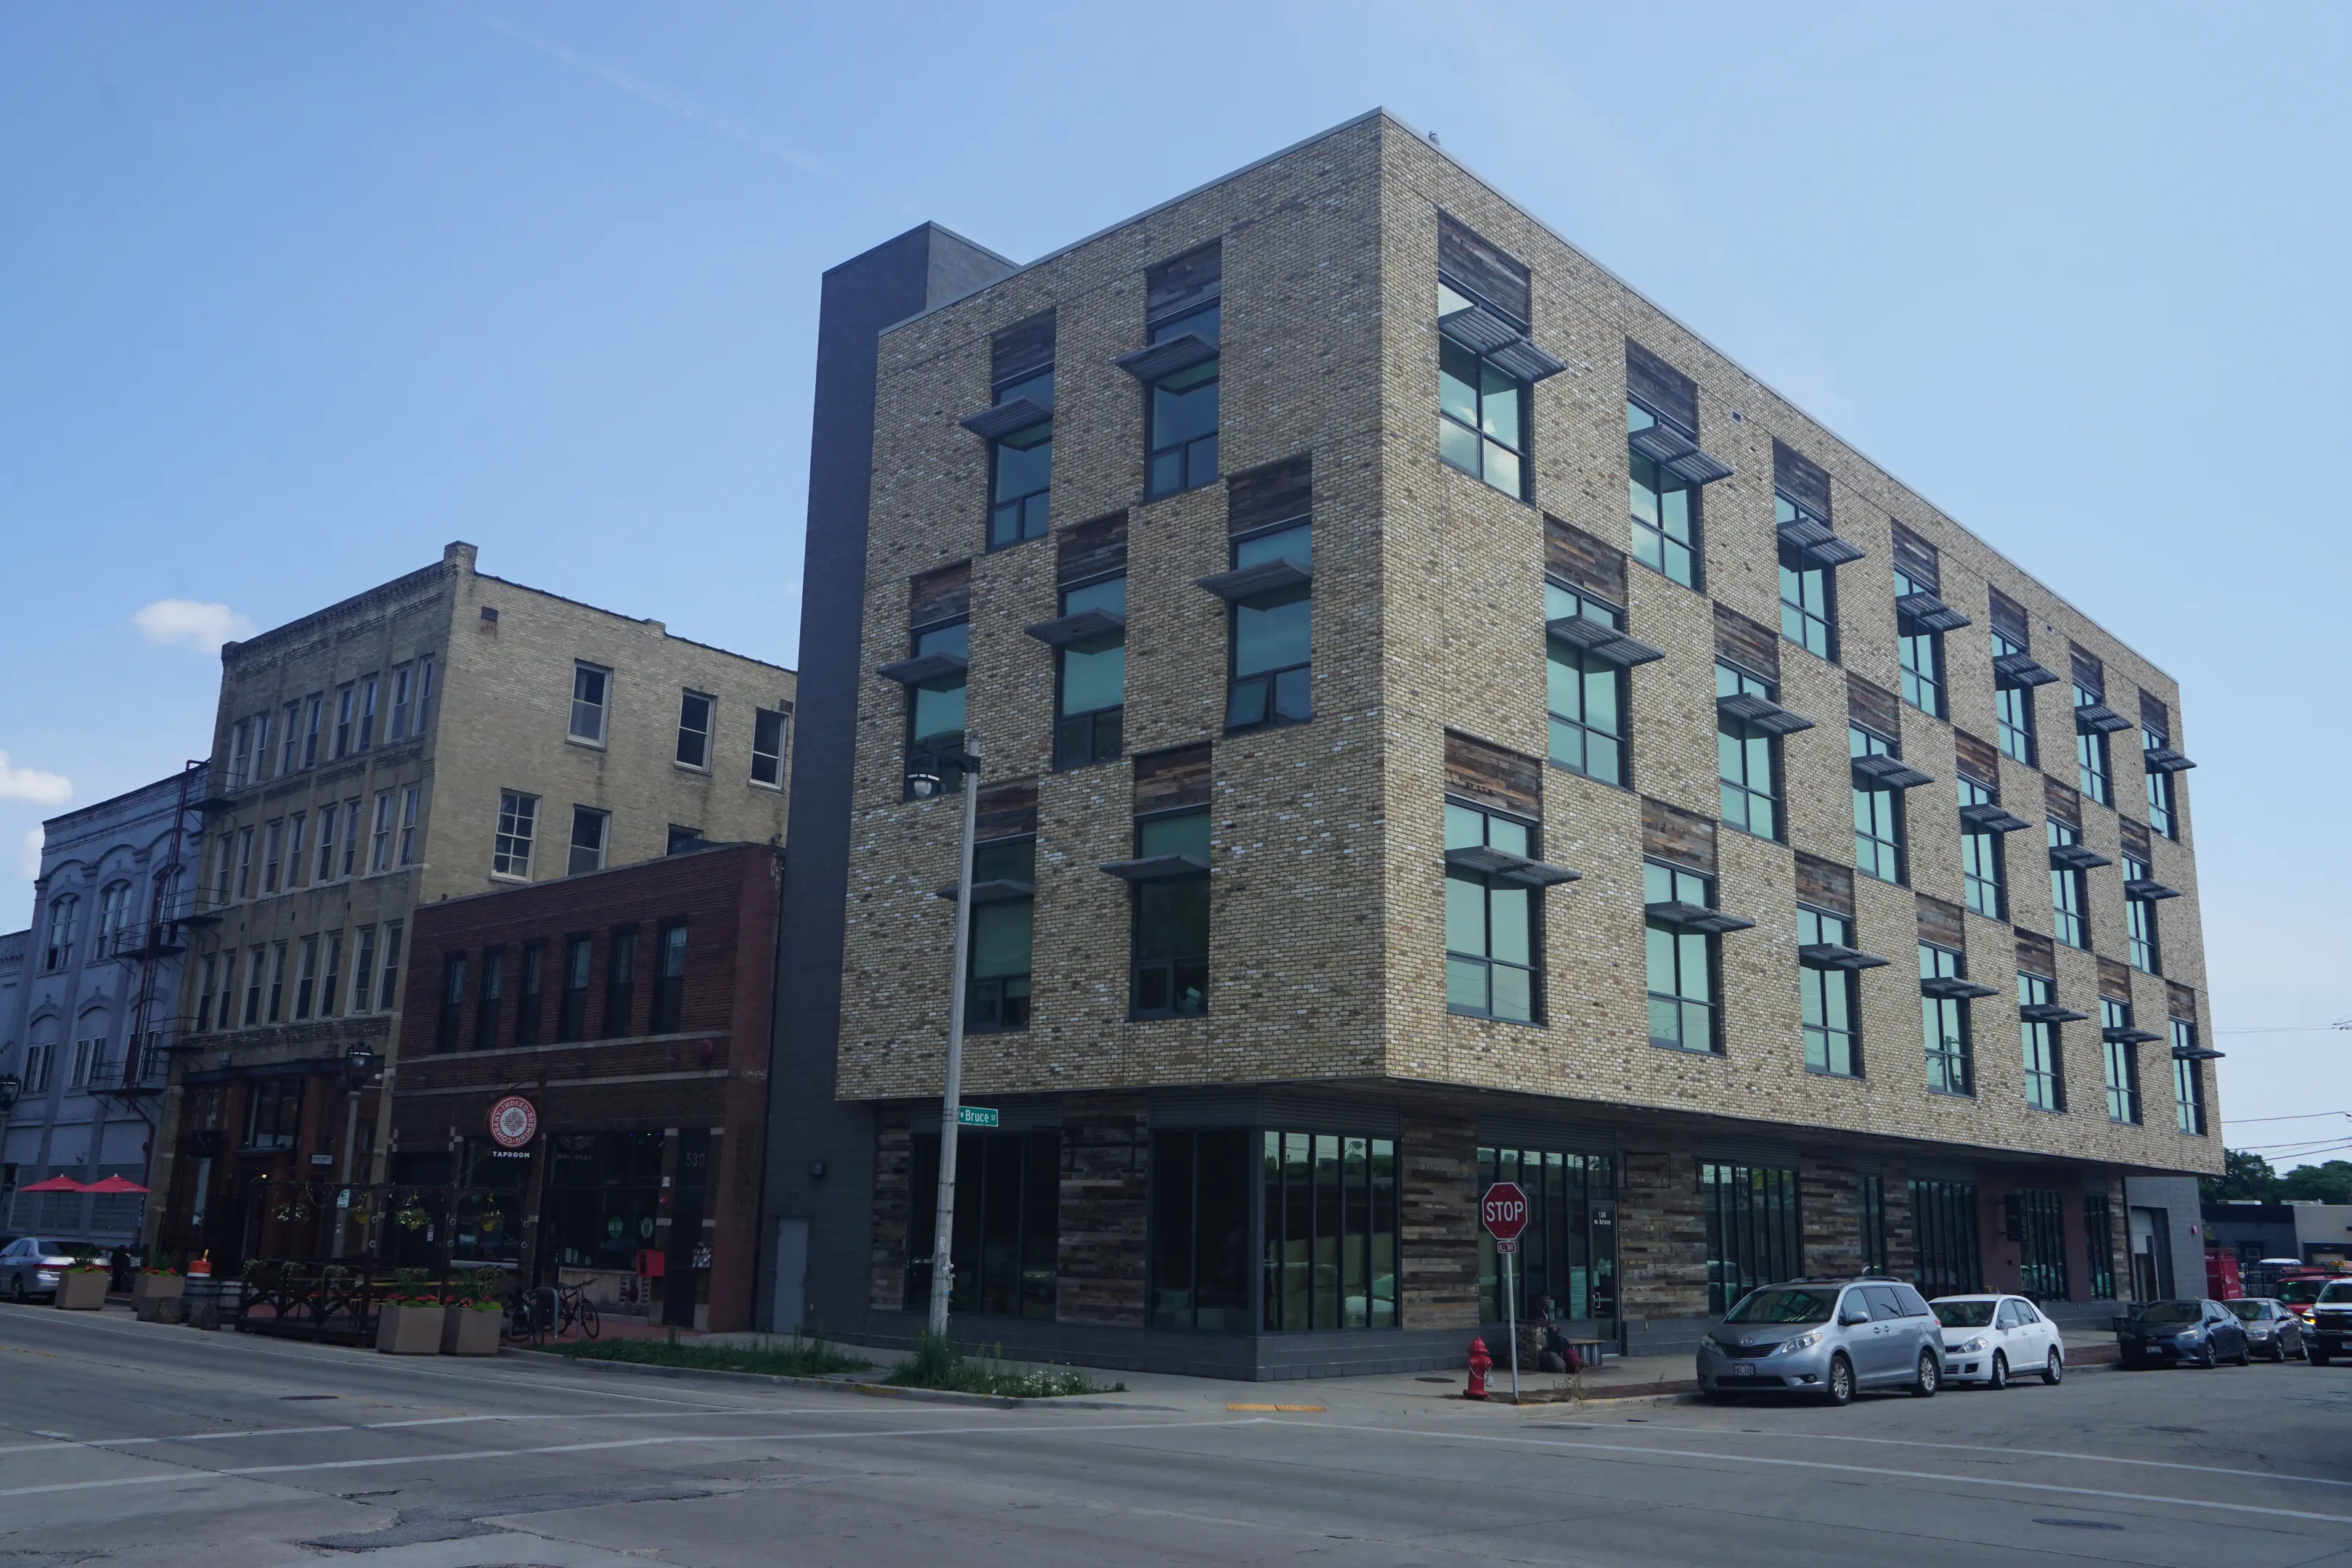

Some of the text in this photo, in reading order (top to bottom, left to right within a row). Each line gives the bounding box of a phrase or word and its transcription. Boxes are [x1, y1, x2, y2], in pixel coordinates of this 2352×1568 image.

[494, 1100, 534, 1144] INDEED BREWING COMPANY
[965, 1109, 989, 1123] Bruce
[685, 1151, 706, 1167] 530
[1486, 1201, 1524, 1222] STOP
